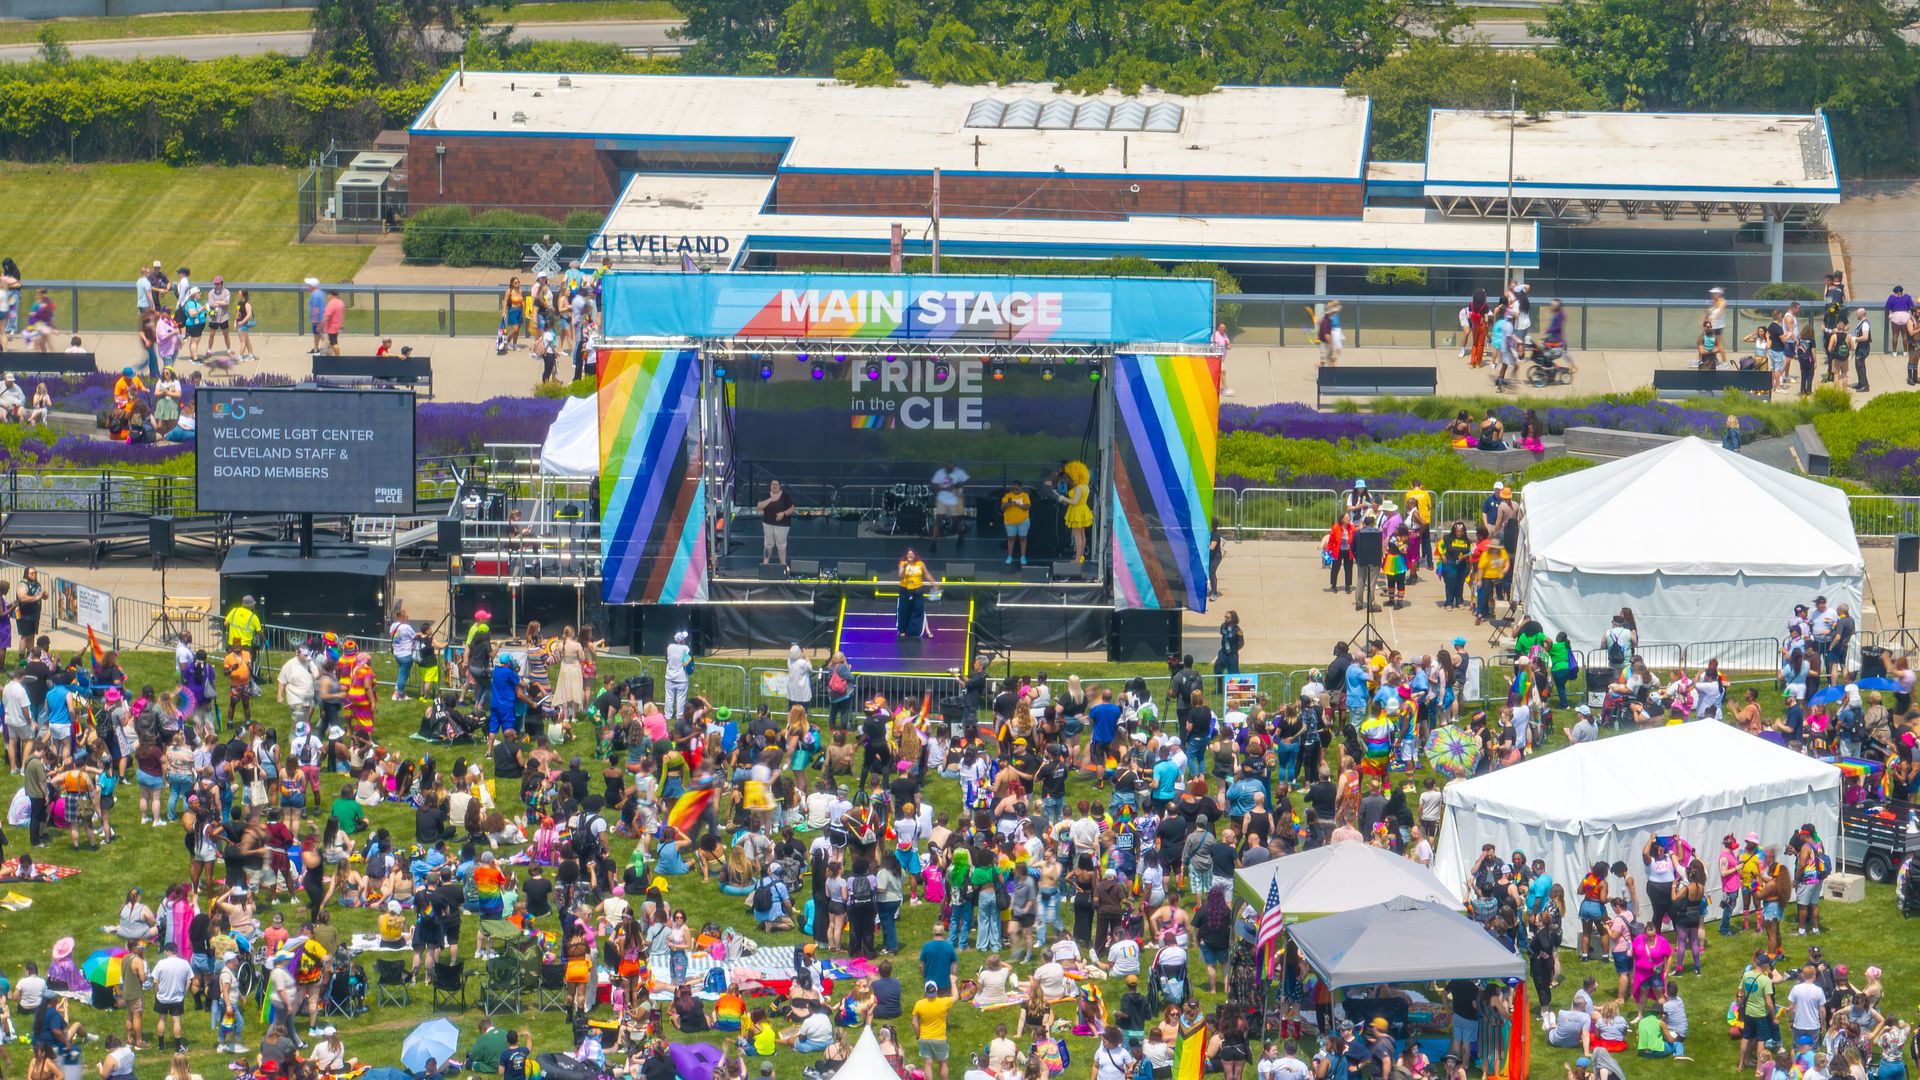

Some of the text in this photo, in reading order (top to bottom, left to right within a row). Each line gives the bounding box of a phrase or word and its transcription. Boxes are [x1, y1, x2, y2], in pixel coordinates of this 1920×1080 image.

[586, 233, 729, 254] CLEVELAND
[781, 289, 1063, 325] MAIN STAGE
[851, 360, 983, 392] PRIDE
[851, 396, 983, 430] in the CLE
[213, 428, 374, 441] WELCOME LGBT CENTER
[213, 447, 349, 460] CLEVELAND STAFF &
[213, 466, 329, 478] BOARD MEMBERS
[375, 488, 402, 496] PRIDE
[385, 495, 402, 503] CLE
